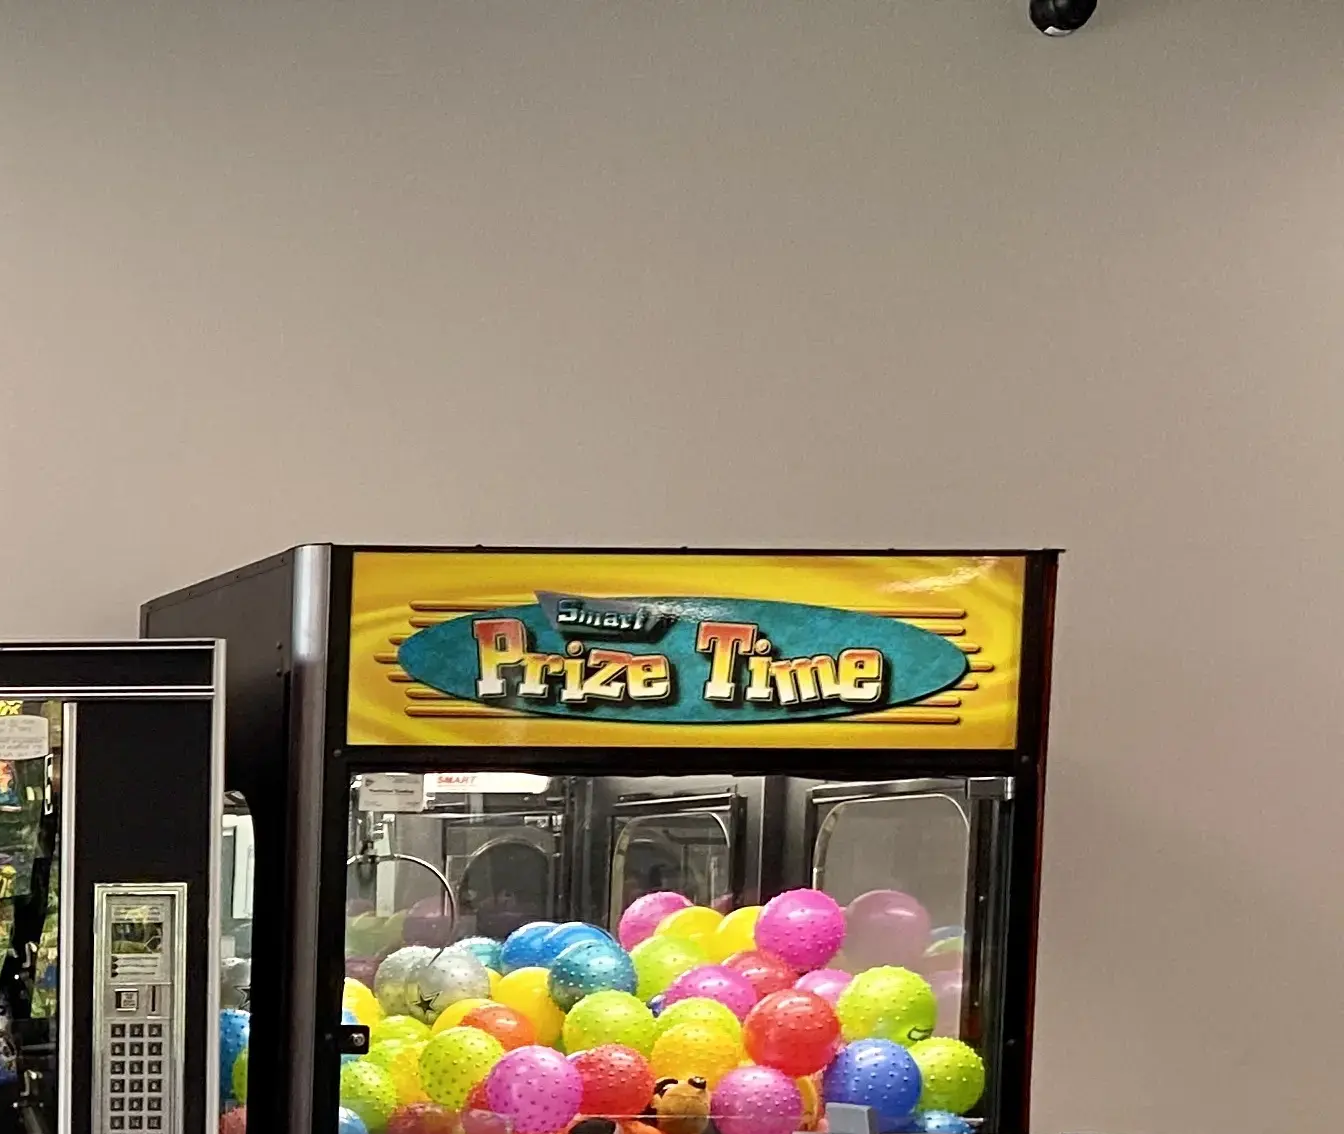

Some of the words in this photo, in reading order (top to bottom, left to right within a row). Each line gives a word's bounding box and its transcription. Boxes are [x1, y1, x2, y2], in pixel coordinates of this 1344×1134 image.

[556, 597, 649, 632] Smart
[471, 618, 671, 703] Prize
[696, 621, 884, 704] Time
